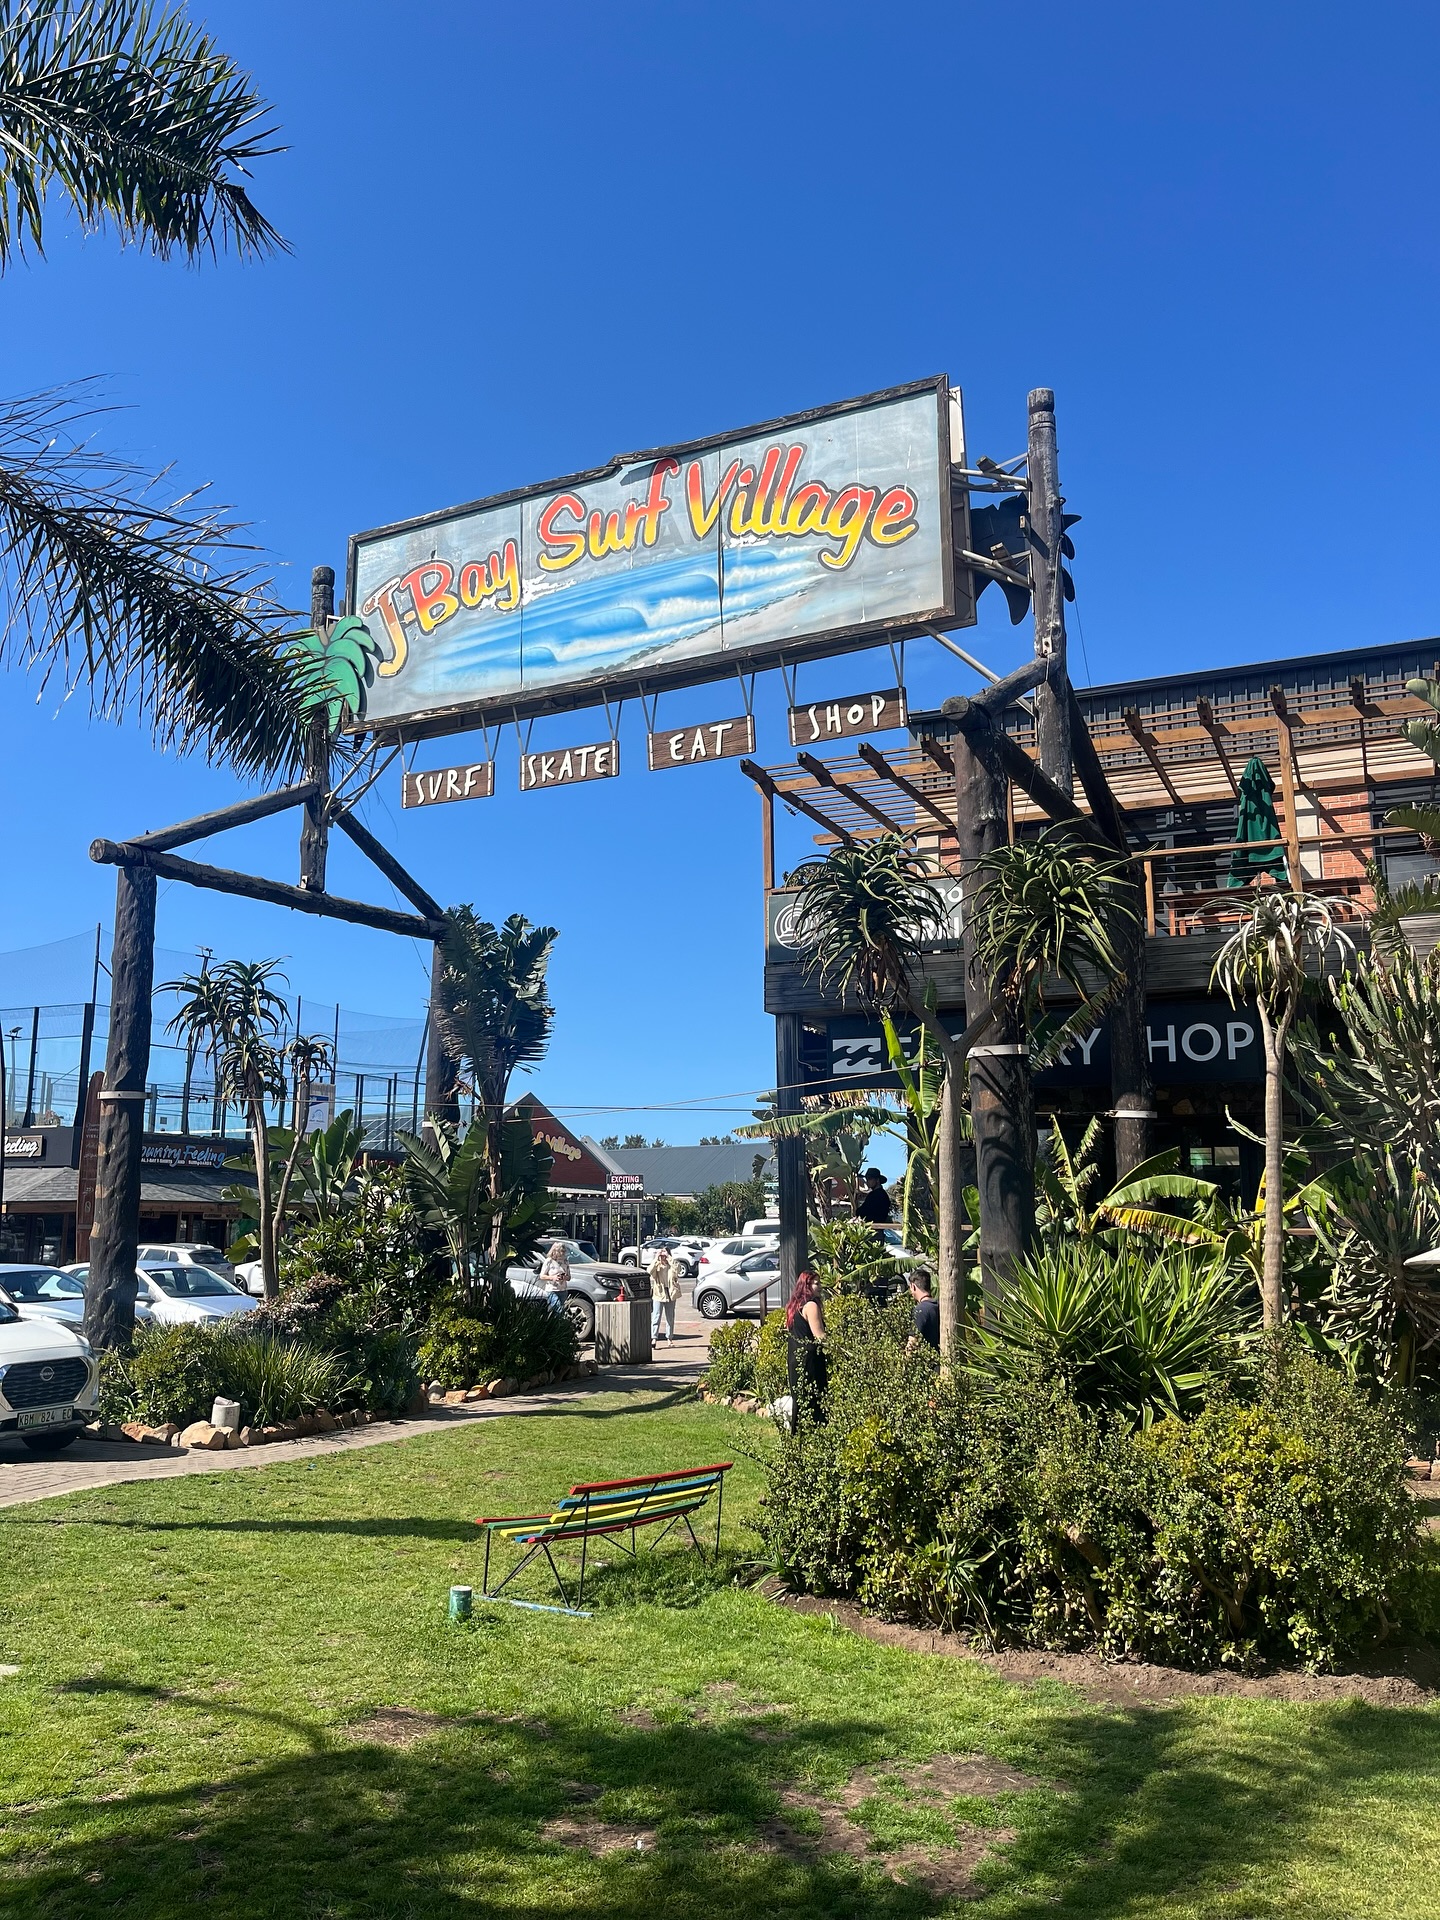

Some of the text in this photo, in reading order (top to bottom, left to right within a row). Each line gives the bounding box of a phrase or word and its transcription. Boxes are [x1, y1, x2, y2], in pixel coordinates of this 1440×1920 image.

[362, 442, 919, 679] J-Bay Surf Village
[808, 695, 886, 740] SHOP
[669, 723, 733, 761] EAT
[415, 765, 482, 804] SURF
[527, 746, 610, 787] SKATE
[1146, 1021, 1254, 1062] HOP
[546, 1134, 581, 1161] Village
[19, 1409, 72, 1426] KBM 824 EC
